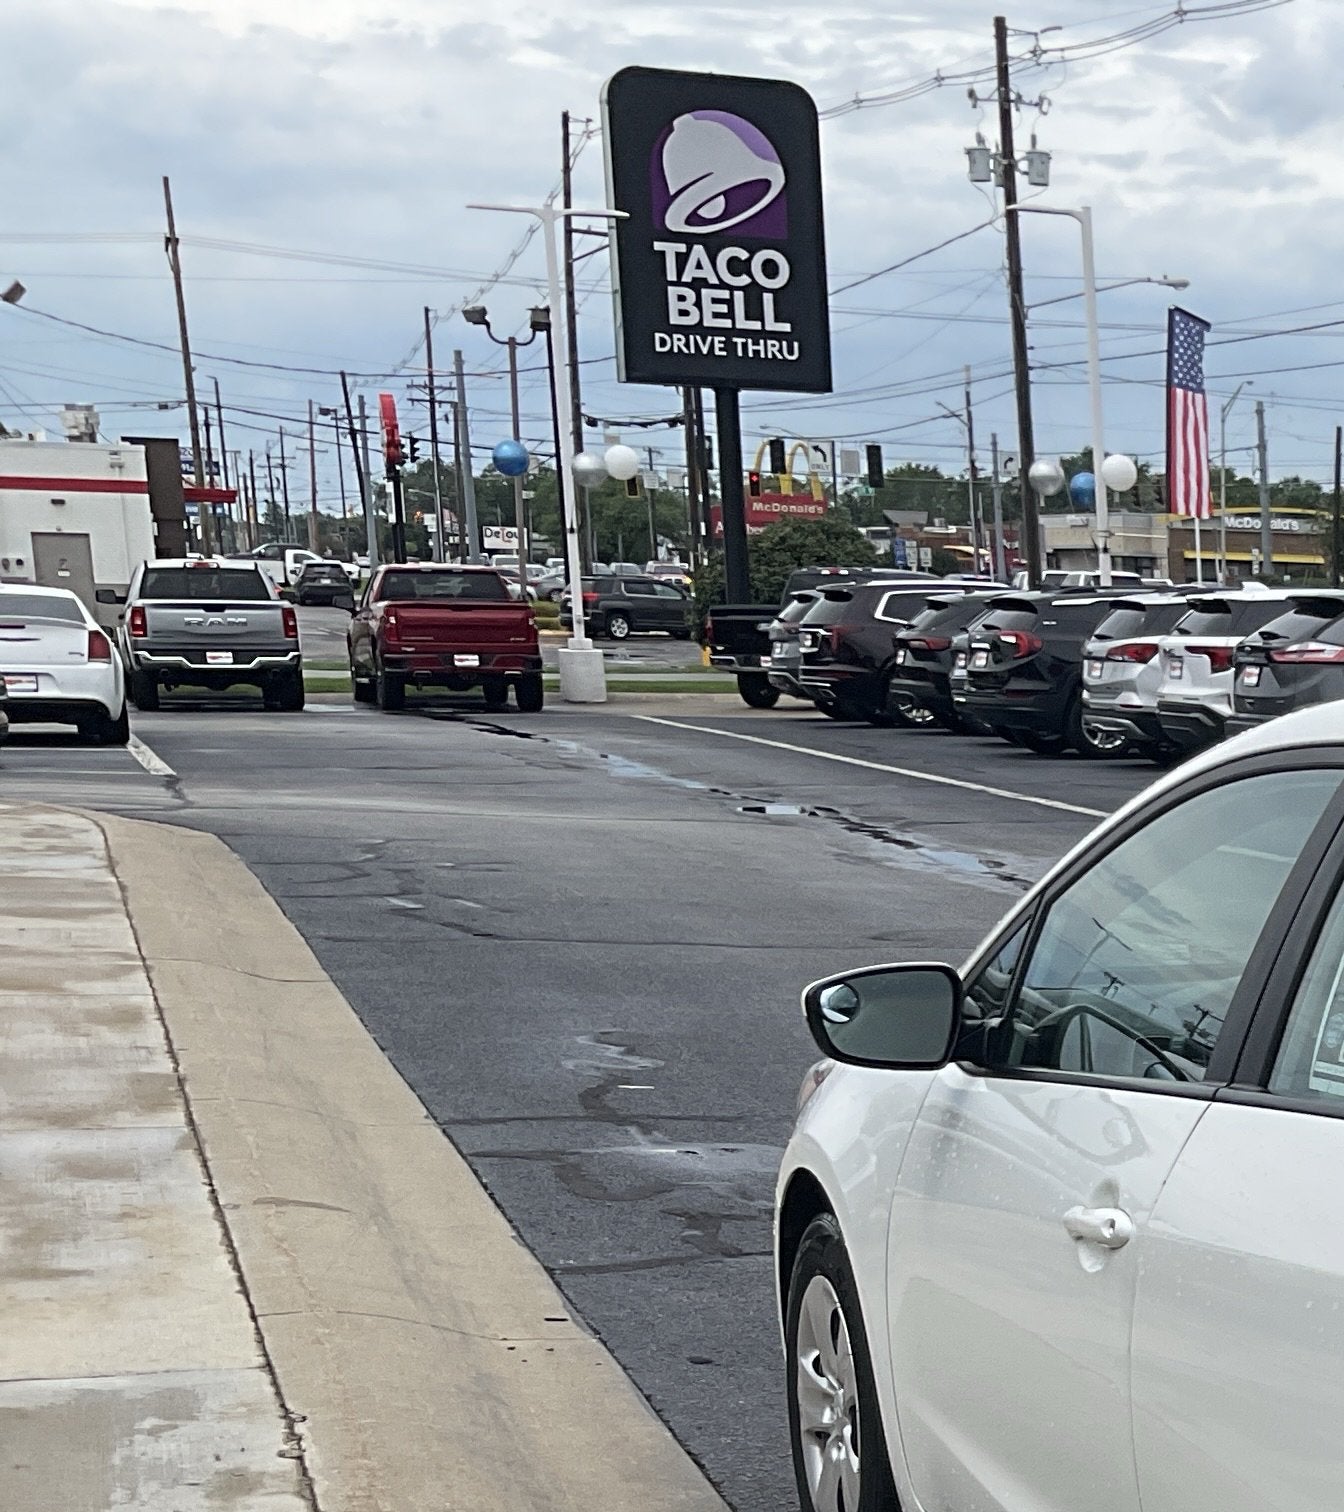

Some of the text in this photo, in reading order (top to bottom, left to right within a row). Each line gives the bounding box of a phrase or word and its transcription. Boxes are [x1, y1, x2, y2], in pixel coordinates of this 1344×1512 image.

[653, 241, 790, 289] TACO
[667, 285, 792, 332] BELL
[654, 332, 799, 360] DRIVE THRU
[752, 502, 824, 514] McDonald's
[1224, 516, 1300, 531] McDoald's
[184, 617, 247, 627] RAM
